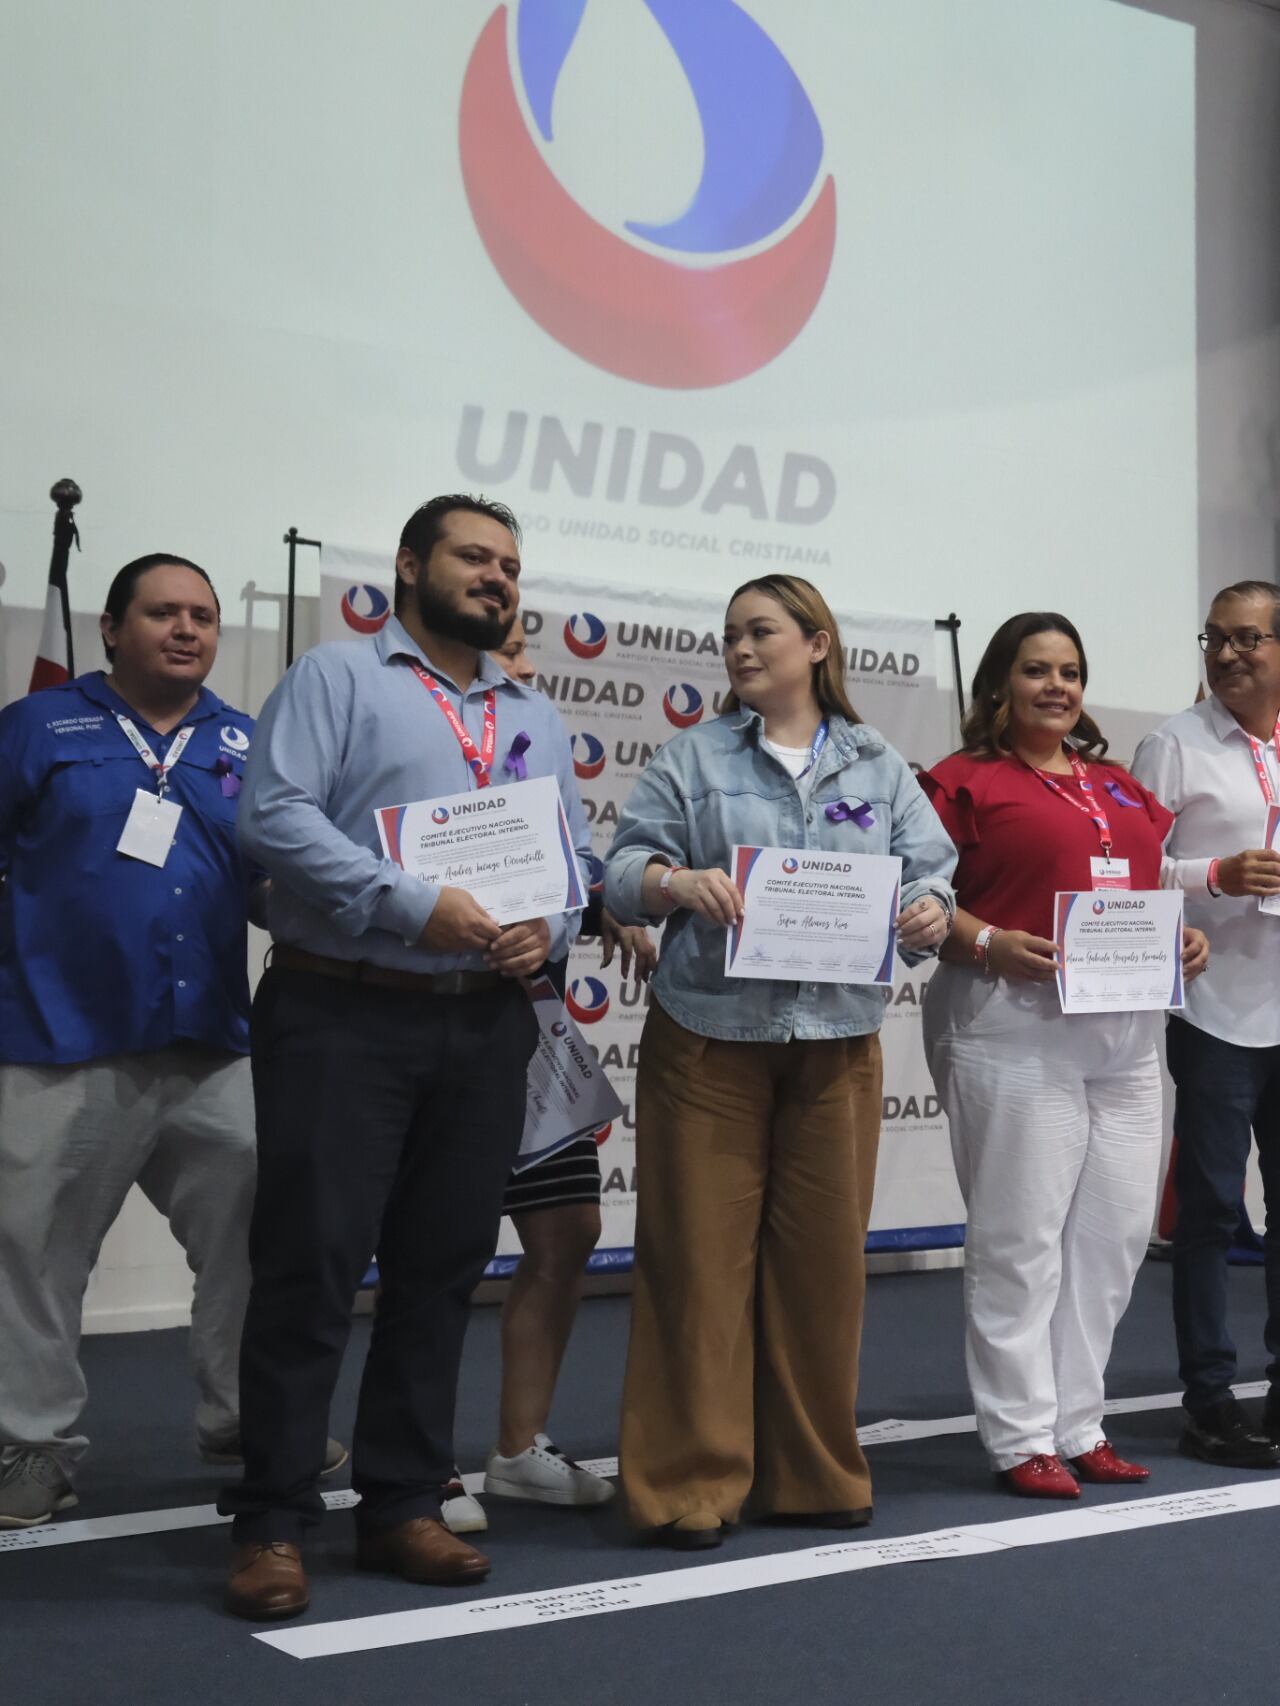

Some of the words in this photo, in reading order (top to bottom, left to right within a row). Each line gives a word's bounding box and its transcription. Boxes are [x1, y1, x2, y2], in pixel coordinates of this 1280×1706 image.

[455, 404, 837, 526] UNIDAD
[558, 518, 640, 545] UNIDAD
[647, 528, 721, 554] SOCIAL
[729, 539, 832, 567] CRISTIANA
[617, 622, 725, 656] UNIDA
[844, 647, 920, 676] IDAD
[529, 673, 645, 707] NIDAD
[447, 710, 465, 738] UNIDAD
[219, 745, 247, 761] UNIDAD
[452, 798, 506, 815] UNIDAD
[448, 824, 487, 836] EJECUTIVO
[489, 818, 524, 828] NACIONAL
[421, 838, 454, 849] TRIBUNAL
[456, 831, 496, 843] ELECTORAL
[499, 824, 529, 834] INTERNO
[801, 860, 852, 873] UNIDAD
[765, 886, 796, 894] TRIBUNAL
[798, 889, 835, 897] ELECTORAL
[793, 881, 829, 889] EJECUTIVO
[830, 884, 863, 892] NACIONAL
[1107, 901, 1145, 909] UNIDAD
[564, 1036, 593, 1080] UNIDAD
[882, 1095, 941, 1120] DAD
[936, 1534, 961, 1542] EN
[815, 1540, 931, 1557] PROPIEDAD
[611, 1582, 642, 1590] EN
[469, 1589, 606, 1613] PROPIEDAD
[538, 1599, 629, 1616] PUESTO
